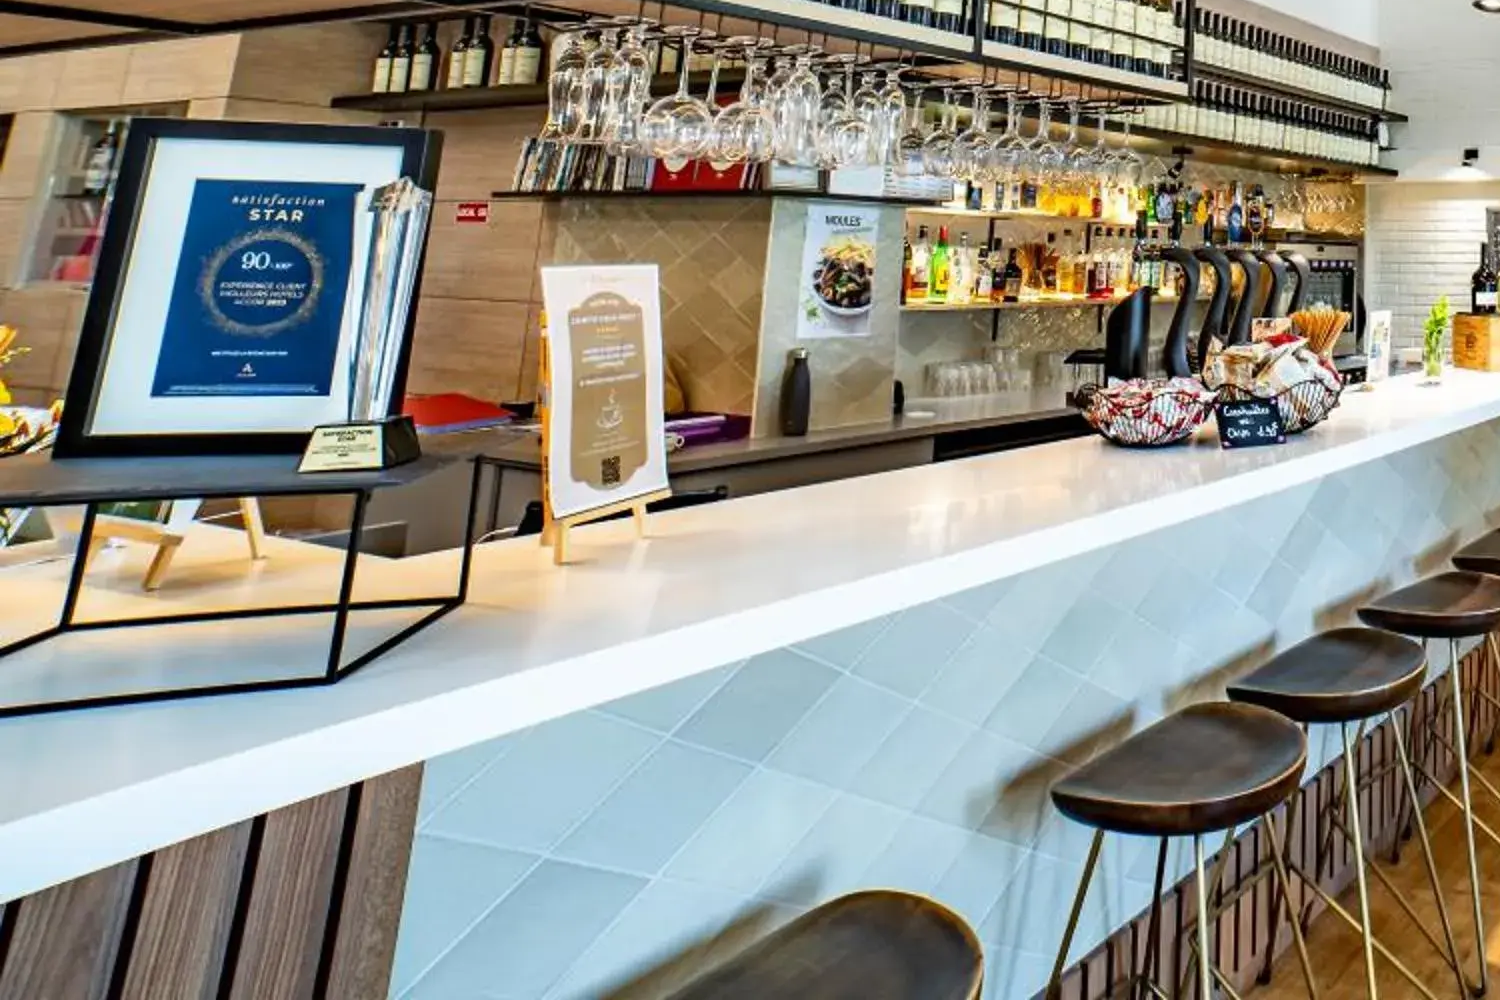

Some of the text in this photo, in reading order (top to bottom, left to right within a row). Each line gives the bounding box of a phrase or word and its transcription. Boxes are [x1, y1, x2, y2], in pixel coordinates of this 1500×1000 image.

[231, 193, 326, 207] satisfaction
[248, 207, 305, 222] STAR
[824, 215, 863, 227] MOULES
[241, 251, 271, 271] 90
